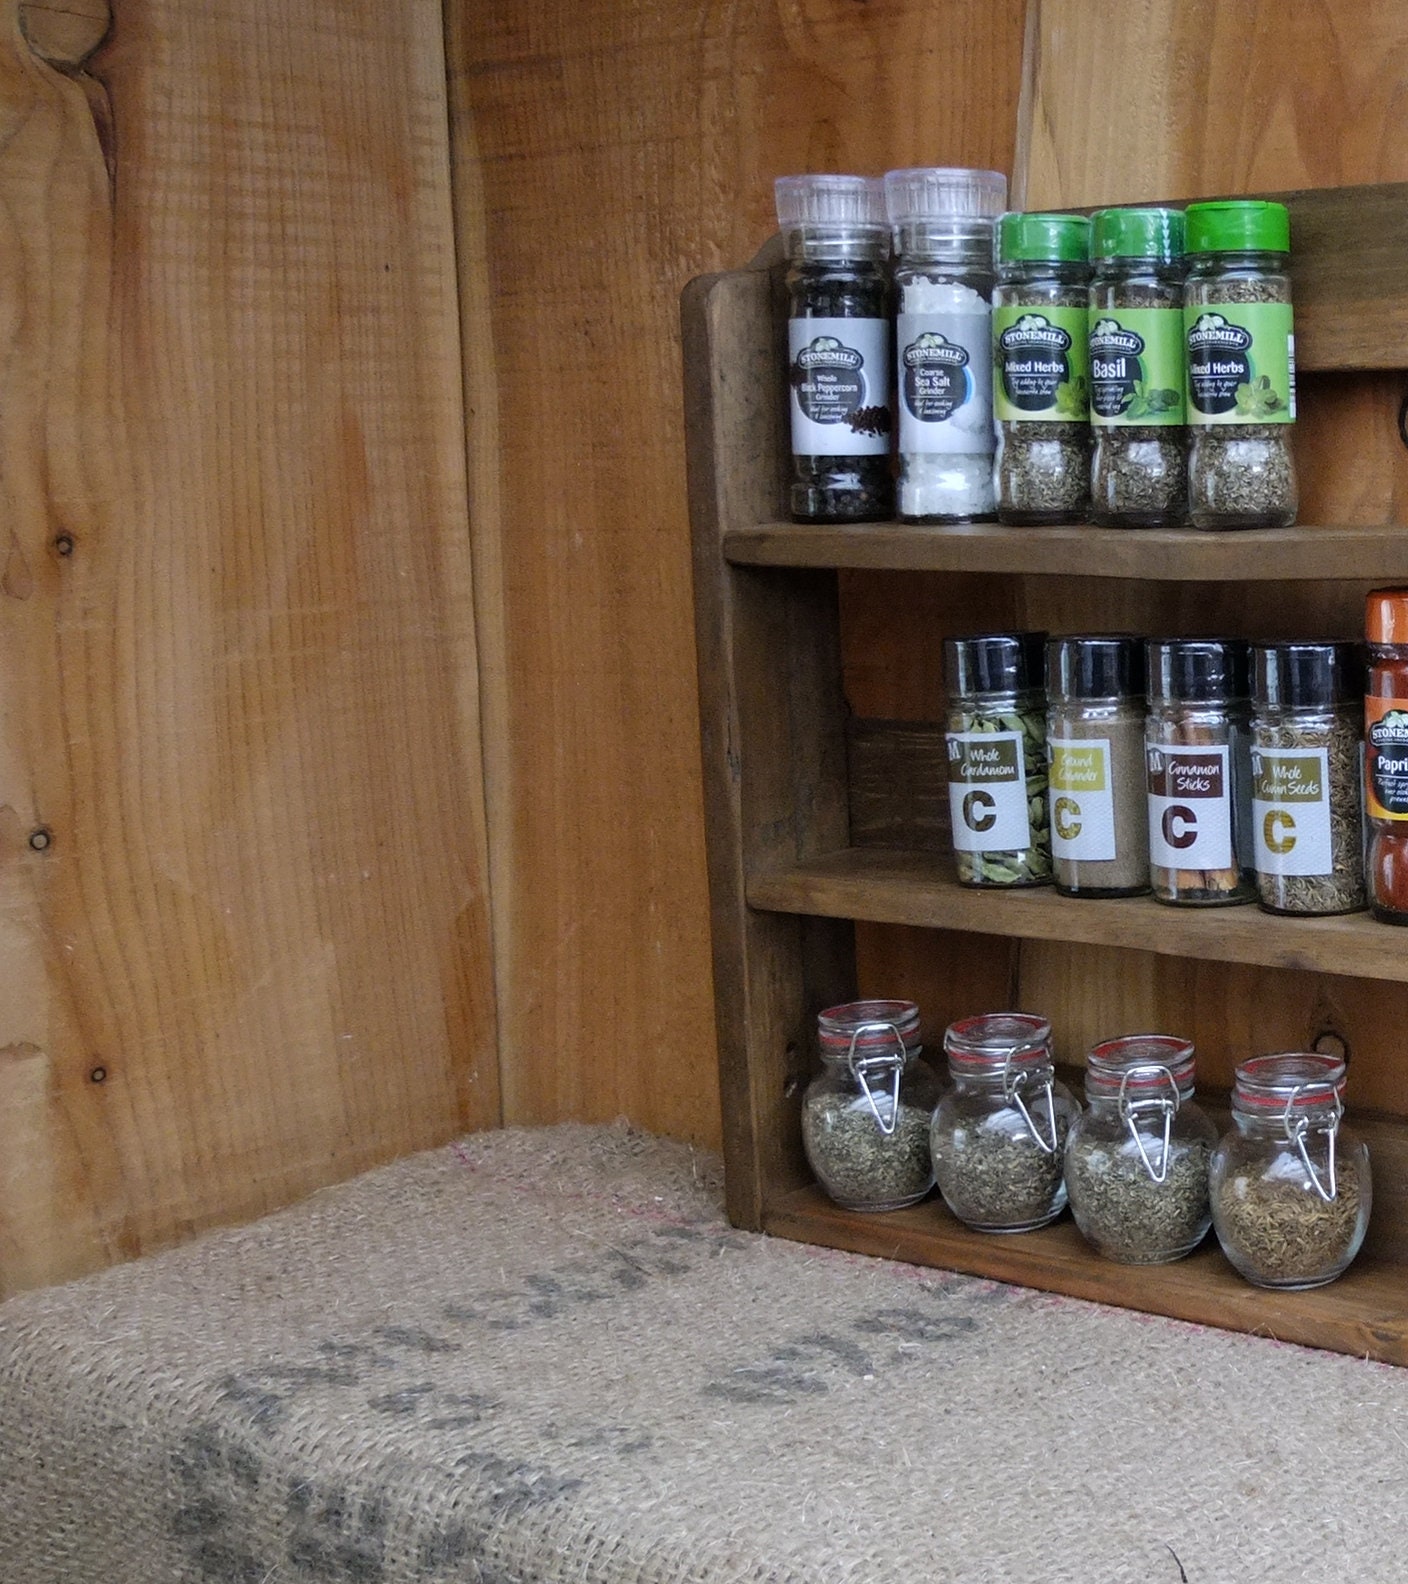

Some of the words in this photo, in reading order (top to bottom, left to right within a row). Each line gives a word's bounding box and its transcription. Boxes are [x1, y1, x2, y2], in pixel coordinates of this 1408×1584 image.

[1005, 330, 1065, 345] STONEMILL
[801, 351, 858, 364] STONEMILL
[906, 348, 962, 361] STONEMILL
[920, 369, 944, 377] Coarse
[1005, 361, 1032, 373] Mixed
[1034, 361, 1065, 374] Herbs
[1093, 357, 1126, 378] Basil
[1213, 361, 1244, 373] Herbs
[915, 376, 930, 387] Sea
[932, 376, 950, 387] Salt
[818, 383, 858, 395] Peppercorn
[919, 387, 945, 395] Grinder
[970, 748, 1000, 761] Whole
[961, 763, 1014, 776] Cardamom
[1169, 761, 1219, 775] Cinnamon
[1272, 765, 1302, 779] Whole
[1177, 777, 1210, 791] Sticks
[1288, 780, 1320, 795] Seeds
[963, 790, 996, 832] C
[1054, 797, 1081, 839] C
[1162, 805, 1198, 849] C
[1263, 810, 1297, 854] C
